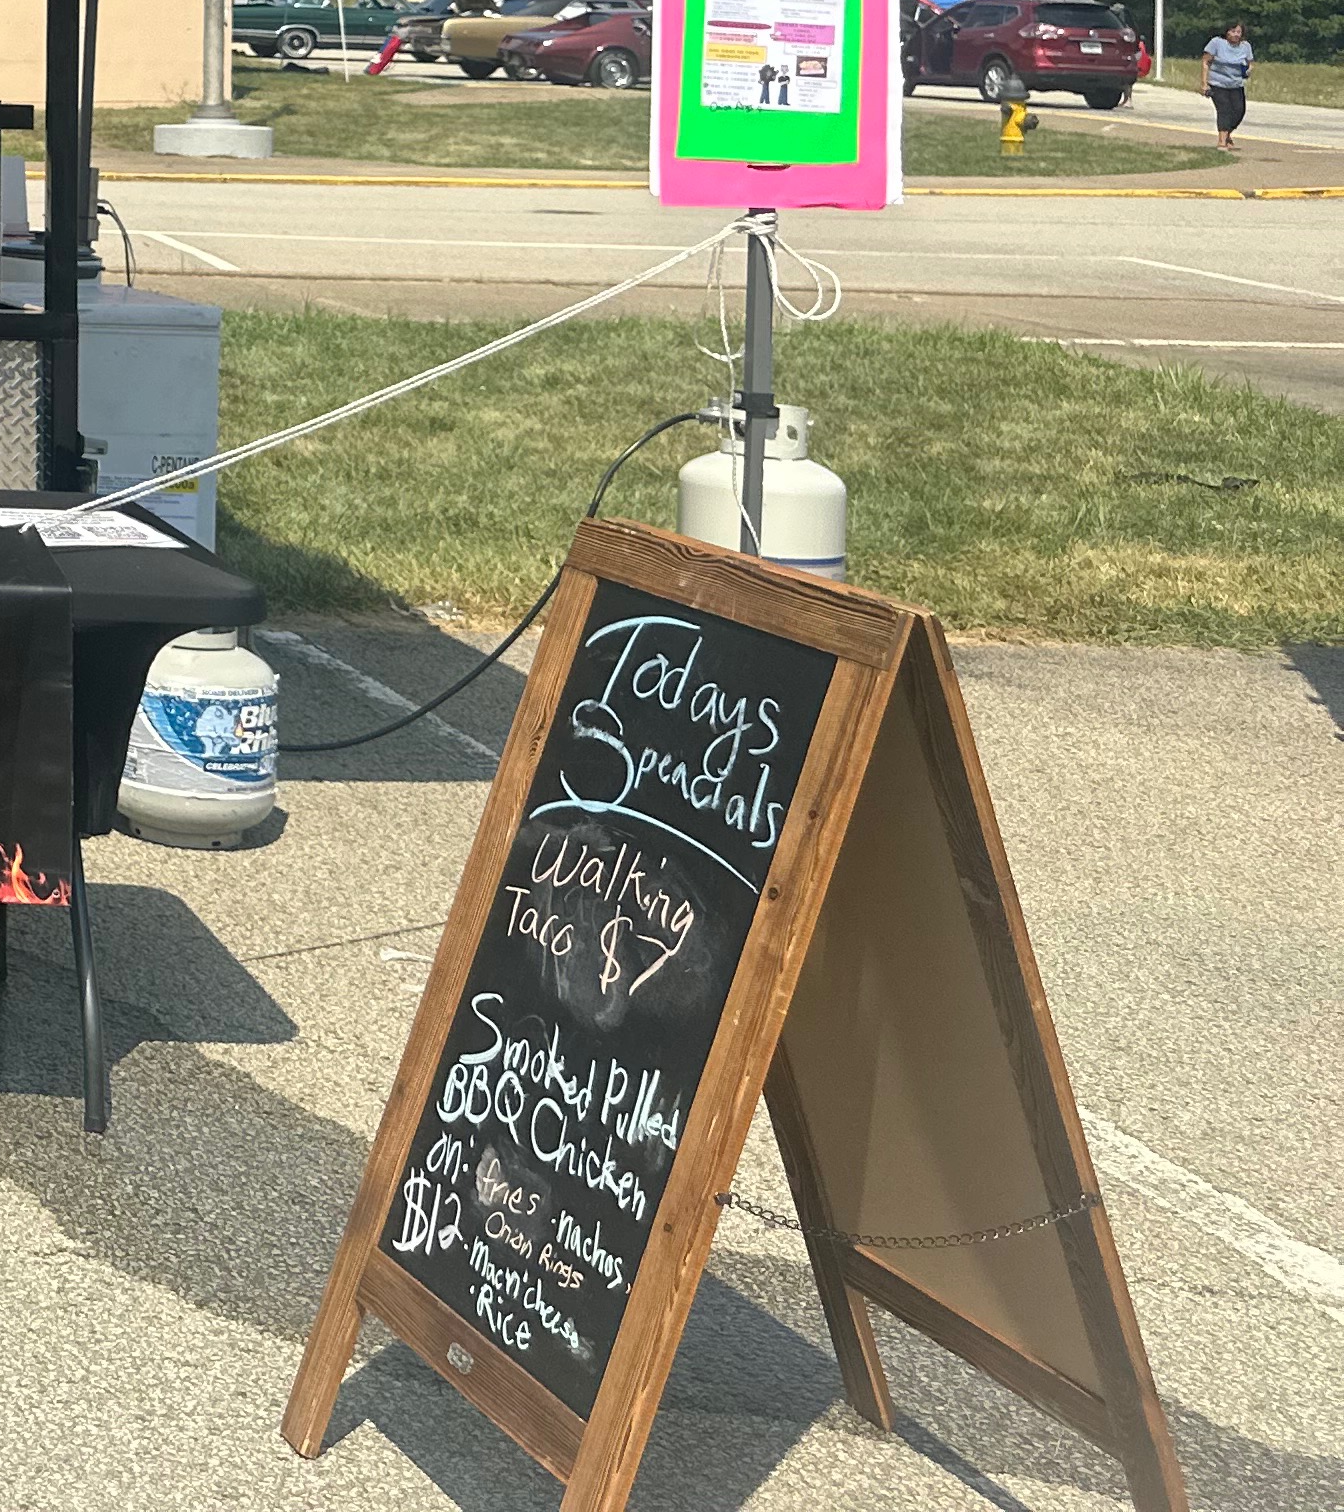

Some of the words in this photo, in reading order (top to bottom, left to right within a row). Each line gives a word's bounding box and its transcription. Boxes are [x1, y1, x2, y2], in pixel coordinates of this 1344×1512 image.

[239, 703, 278, 729] Blu
[585, 615, 782, 782] Todays
[504, 886, 575, 956] Taco
[599, 905, 673, 996] $7
[531, 833, 696, 956] Walking
[459, 992, 597, 1123] Smoked
[436, 1061, 526, 1145] BBQ
[530, 1096, 647, 1221] Chicken
[392, 1167, 464, 1256] $12
[476, 1283, 532, 1350] Rice
